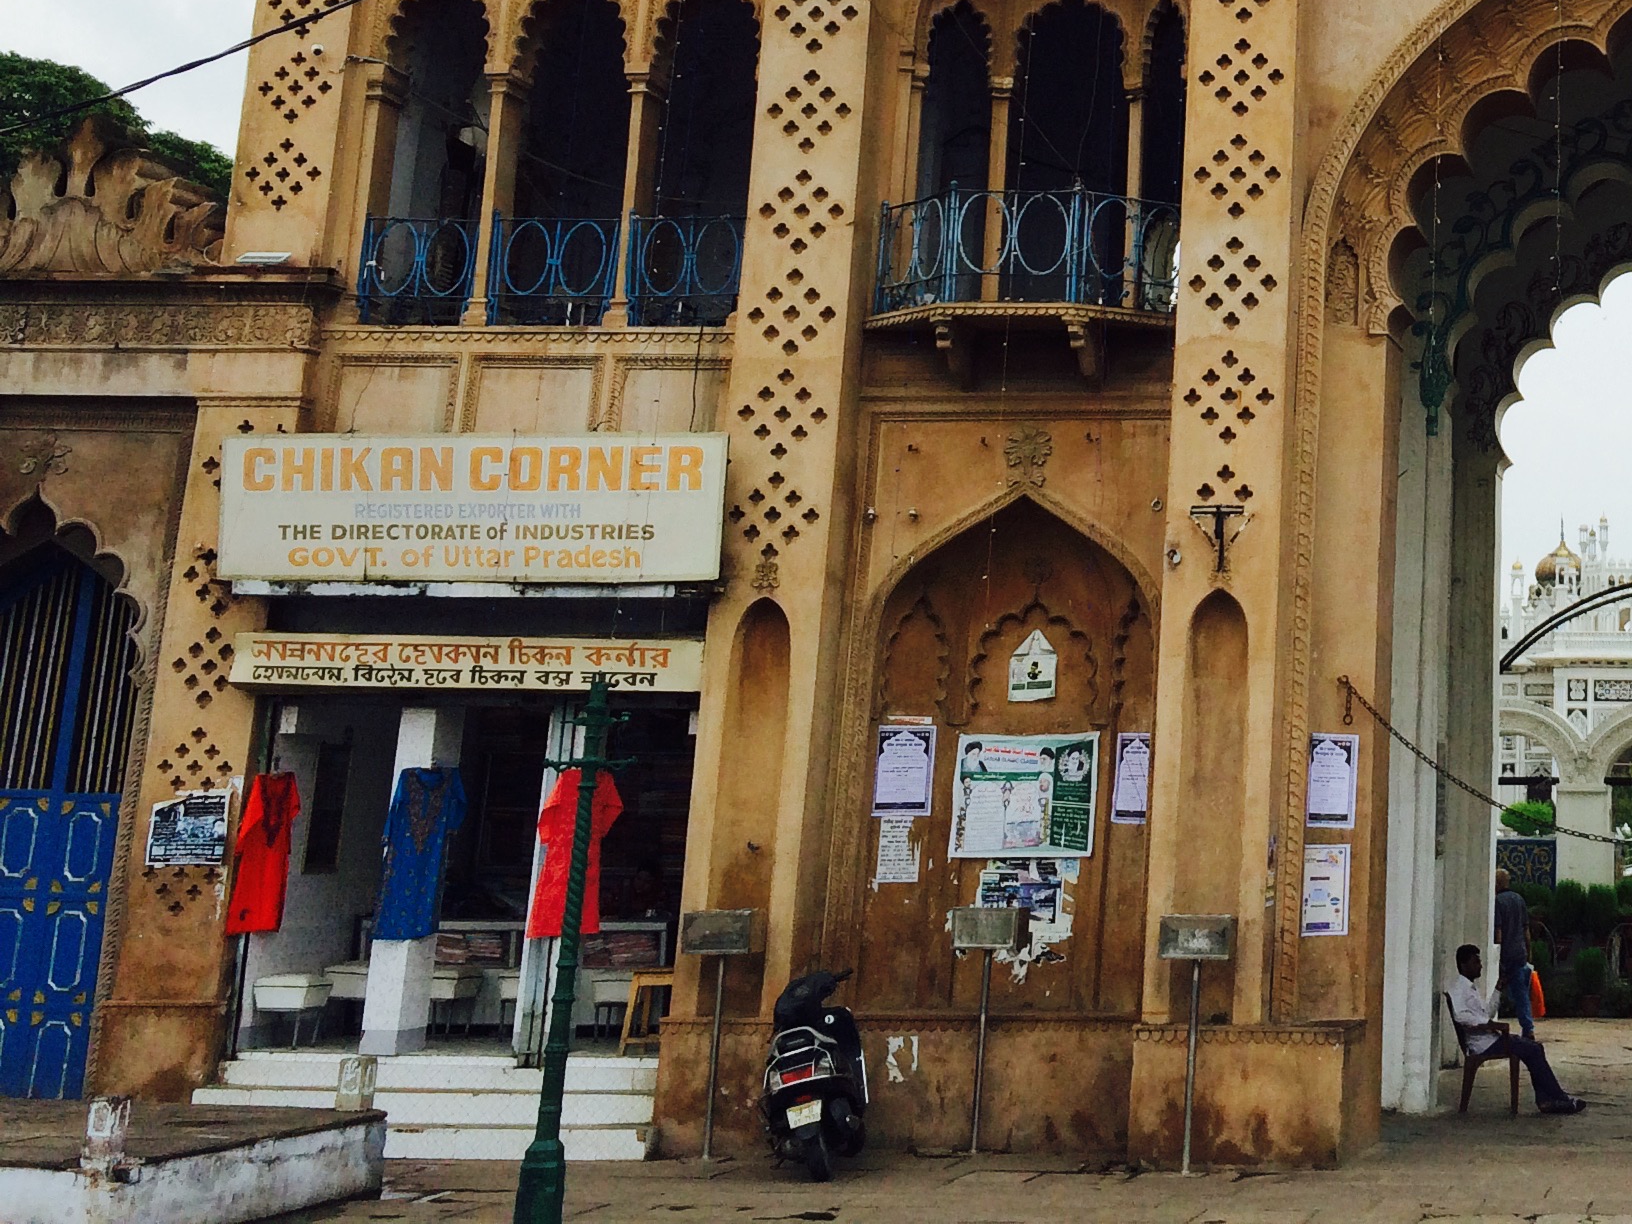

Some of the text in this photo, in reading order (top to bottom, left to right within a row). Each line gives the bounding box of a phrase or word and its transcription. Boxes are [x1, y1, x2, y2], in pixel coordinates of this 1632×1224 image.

[242, 446, 705, 492] CHIKAN CORNER
[355, 502, 581, 519] REGISTERED EXPORTER WITH
[278, 522, 655, 542] THE DIRECTORATE of INDUSTRIES
[288, 545, 642, 569] GOVT. of Uttar Pradesh
[508, 638, 575, 666] চিকন
[469, 665, 527, 687] চিকন
